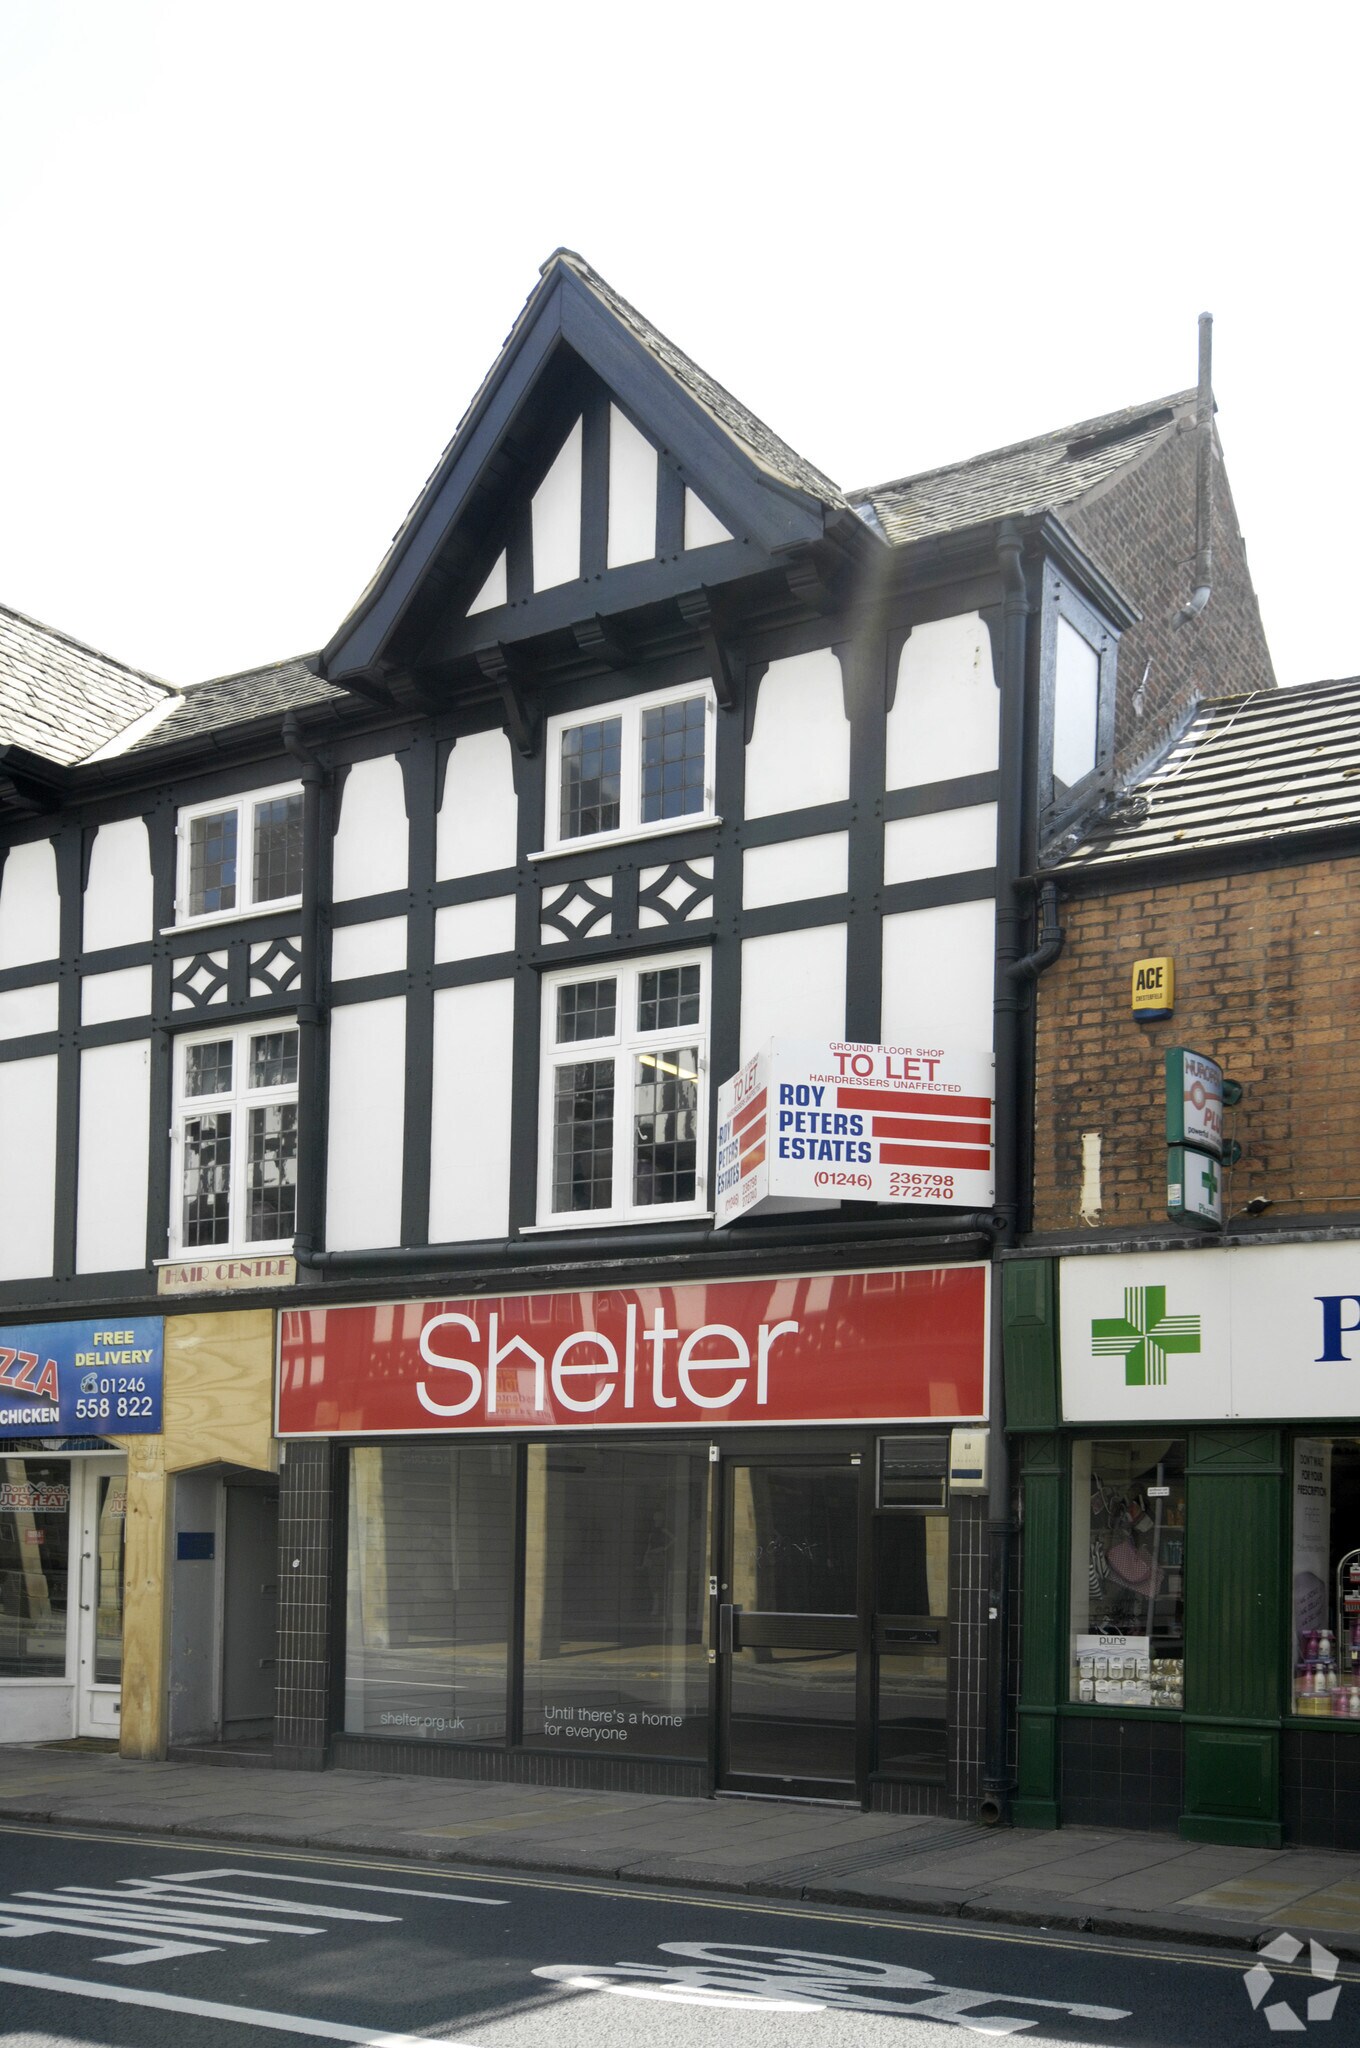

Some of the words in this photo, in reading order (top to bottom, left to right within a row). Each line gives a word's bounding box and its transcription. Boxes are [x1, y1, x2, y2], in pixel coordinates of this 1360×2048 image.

[1136, 966, 1163, 991] ACE
[829, 1042, 874, 1054] GROUND
[877, 1045, 913, 1056] FLOOR
[916, 1048, 945, 1058] SHOP
[833, 1052, 874, 1078] TO
[886, 1056, 941, 1082] LET
[733, 1079, 744, 1105] TO
[744, 1063, 758, 1095] LET
[809, 1073, 890, 1089] HAIRDRESSERS
[893, 1081, 962, 1094] UNAFFECTED
[780, 1083, 826, 1107] ROY
[719, 1120, 731, 1147] ROY
[779, 1111, 864, 1137] PETERS
[718, 1138, 739, 1171] PETERS
[779, 1137, 872, 1164] ESTATES
[717, 1162, 740, 1195] ESTATES
[814, 1171, 872, 1191] (01246)
[889, 1172, 954, 1187] 236798
[889, 1185, 954, 1200] 272740
[165, 1265, 210, 1285] HAIR
[215, 1259, 291, 1281] CENTRE
[93, 1331, 134, 1346] FREE
[75, 1349, 153, 1367] DELIVERY
[416, 1304, 799, 1416] Shelter
[100, 1377, 146, 1394] 01246
[0, 1407, 60, 1424] CHICKEN
[76, 1398, 110, 1418] 558
[117, 1396, 152, 1418] 822
[40, 1484, 67, 1494] cook
[1099, 1636, 1126, 1646] pure
[380, 1712, 465, 1731] shelter.org.uk
[544, 1705, 574, 1720] Until
[578, 1707, 625, 1724] there's
[628, 1714, 637, 1724] a
[641, 1712, 683, 1727] home
[544, 1722, 562, 1736] for
[565, 1725, 627, 1741] everyone
